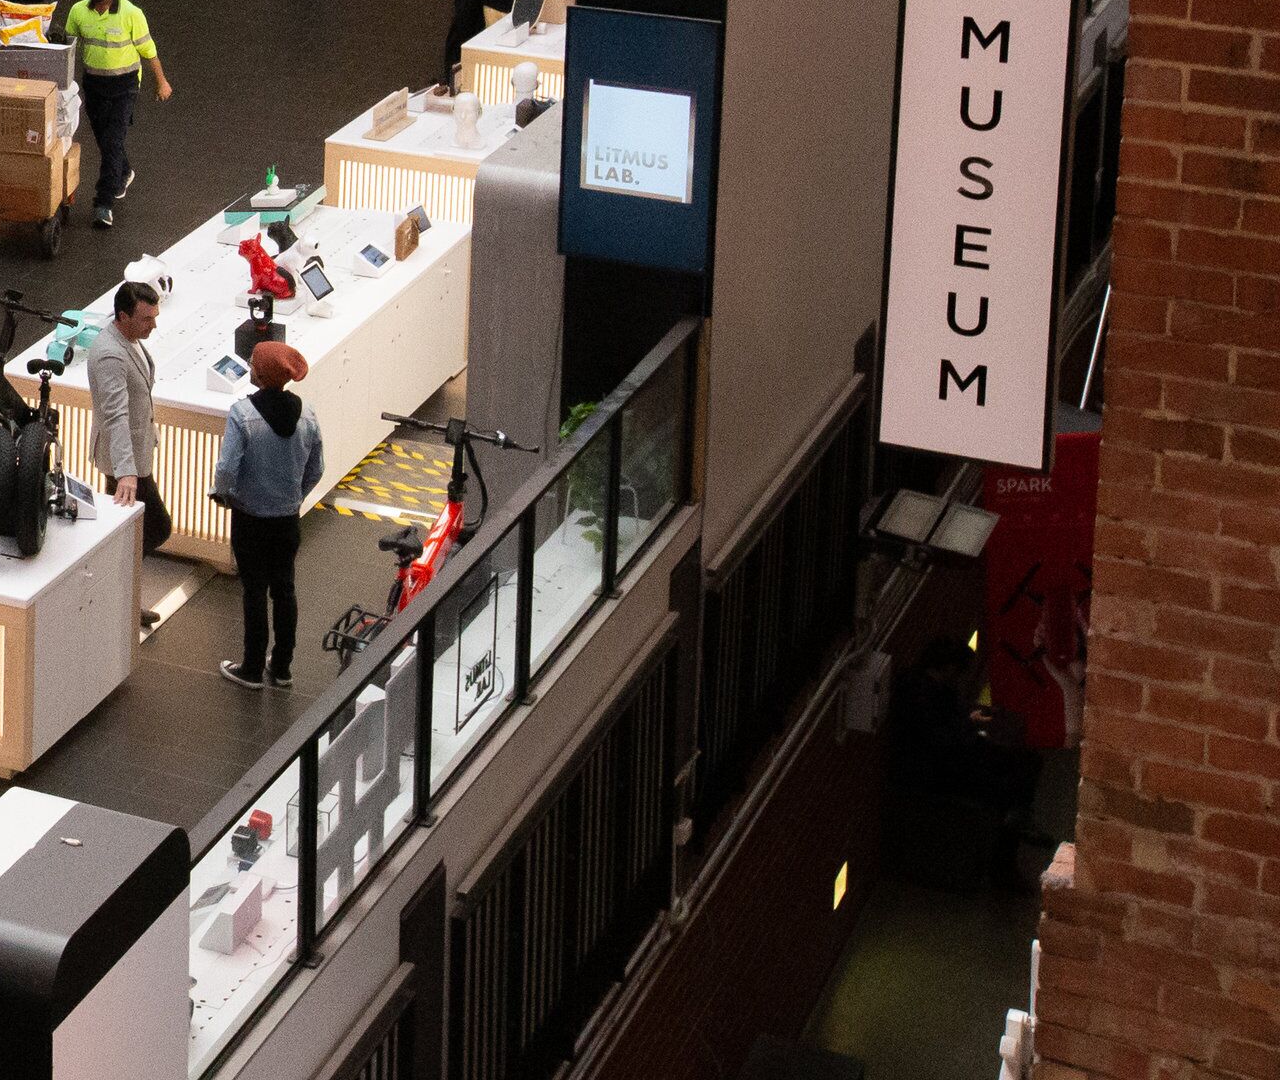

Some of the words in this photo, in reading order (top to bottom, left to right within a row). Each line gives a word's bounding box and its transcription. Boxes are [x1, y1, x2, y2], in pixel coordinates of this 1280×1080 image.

[593, 165, 640, 186] LAB.
[939, 16, 1010, 407] MUSEUM
[997, 477, 1052, 493] SPARK
